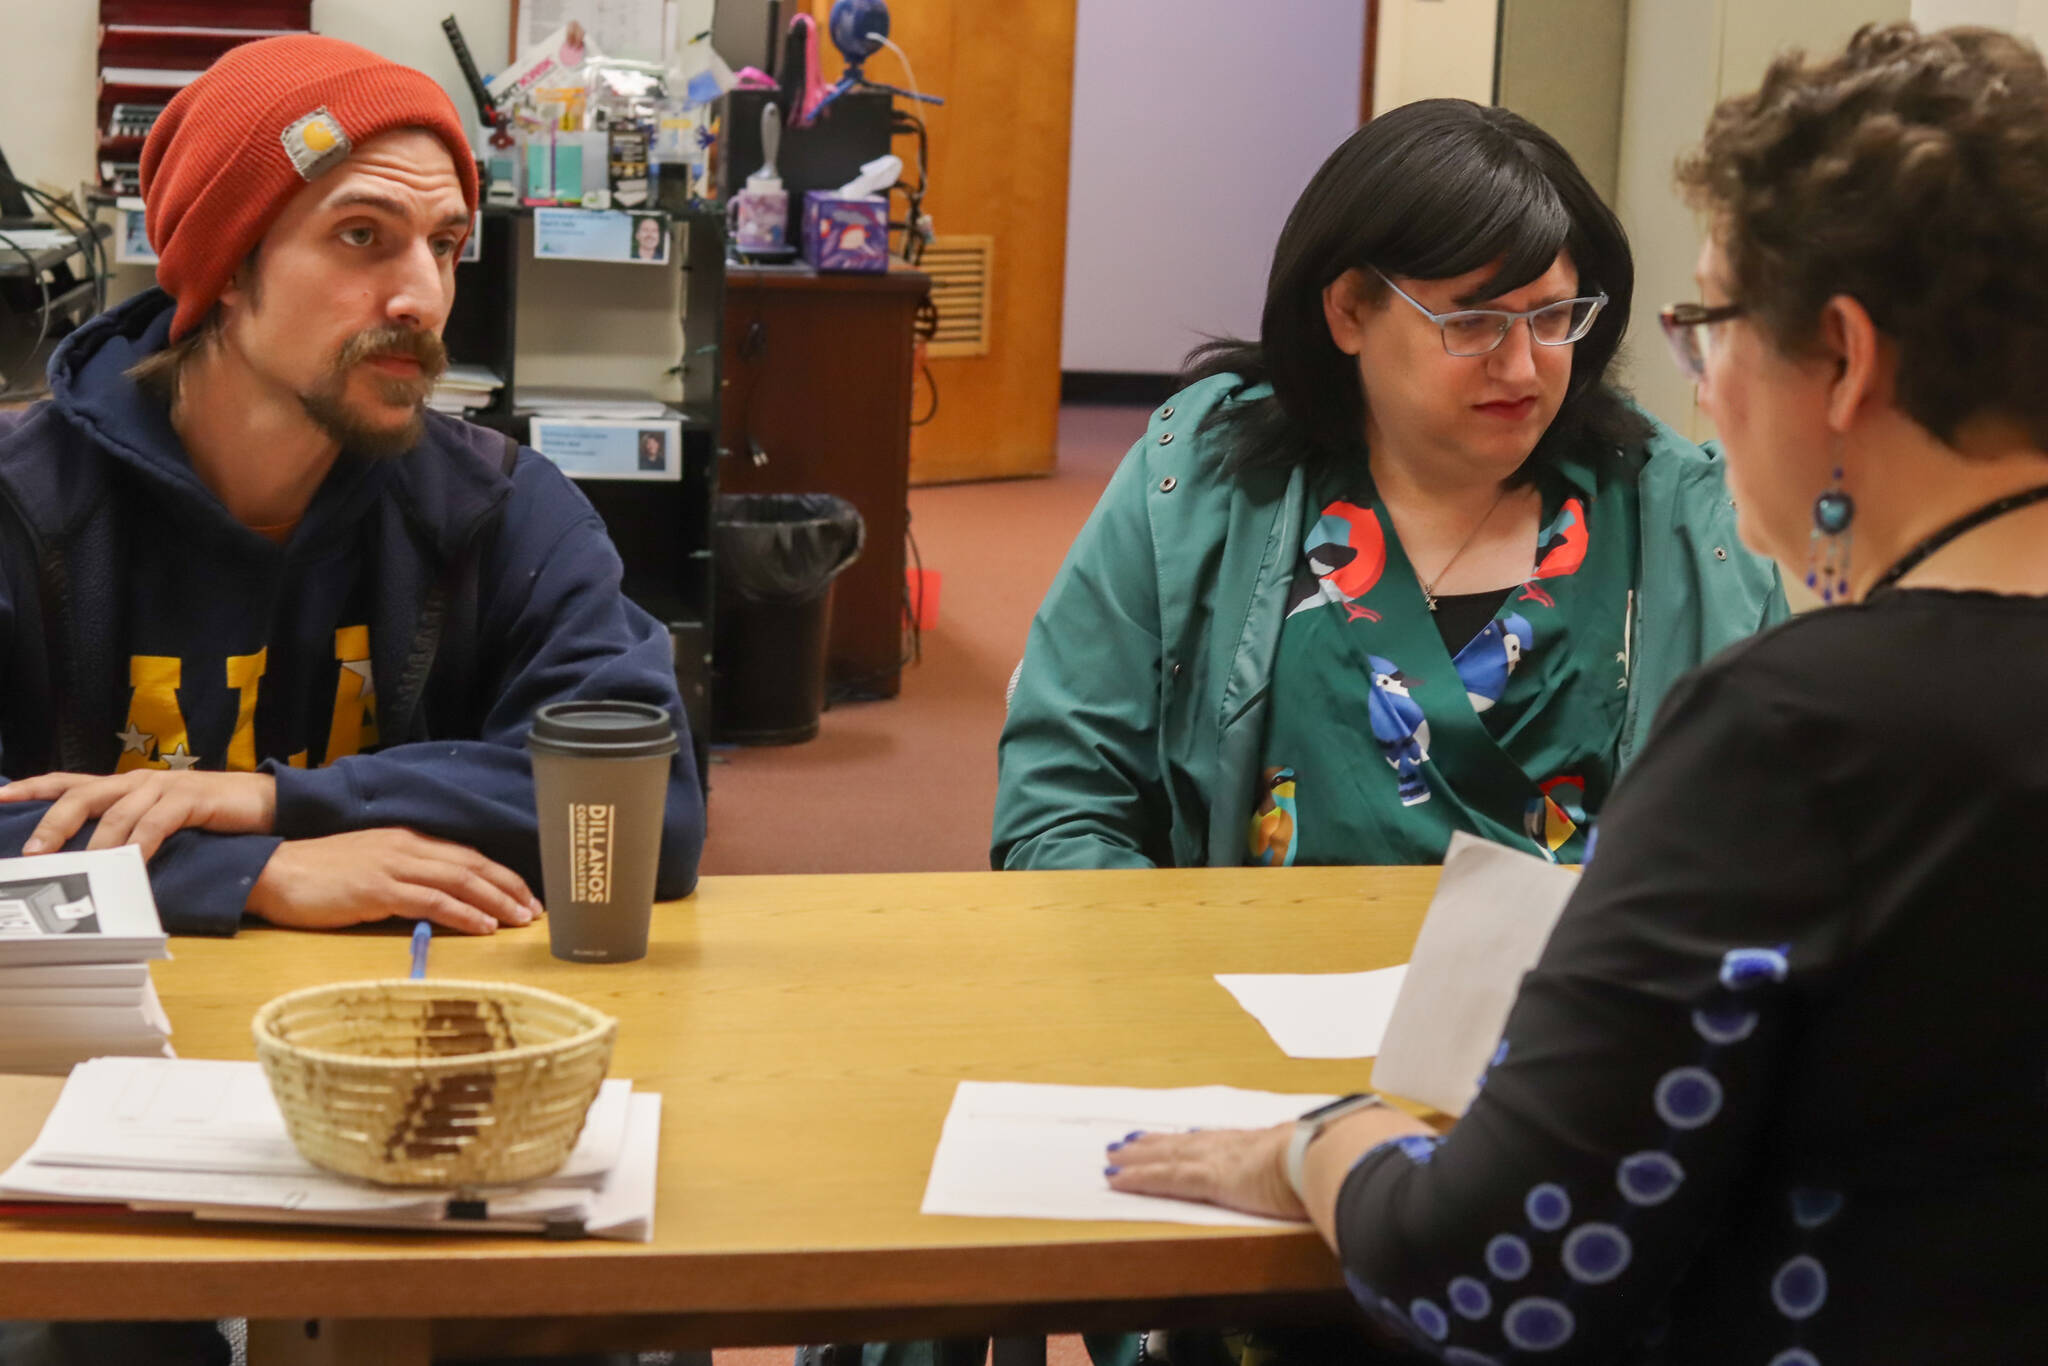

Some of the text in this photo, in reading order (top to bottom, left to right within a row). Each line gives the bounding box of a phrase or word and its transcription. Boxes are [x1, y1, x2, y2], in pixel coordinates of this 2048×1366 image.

[575, 804, 588, 902] COFFEE ROASTERS
[587, 804, 608, 904] DILLANOS
